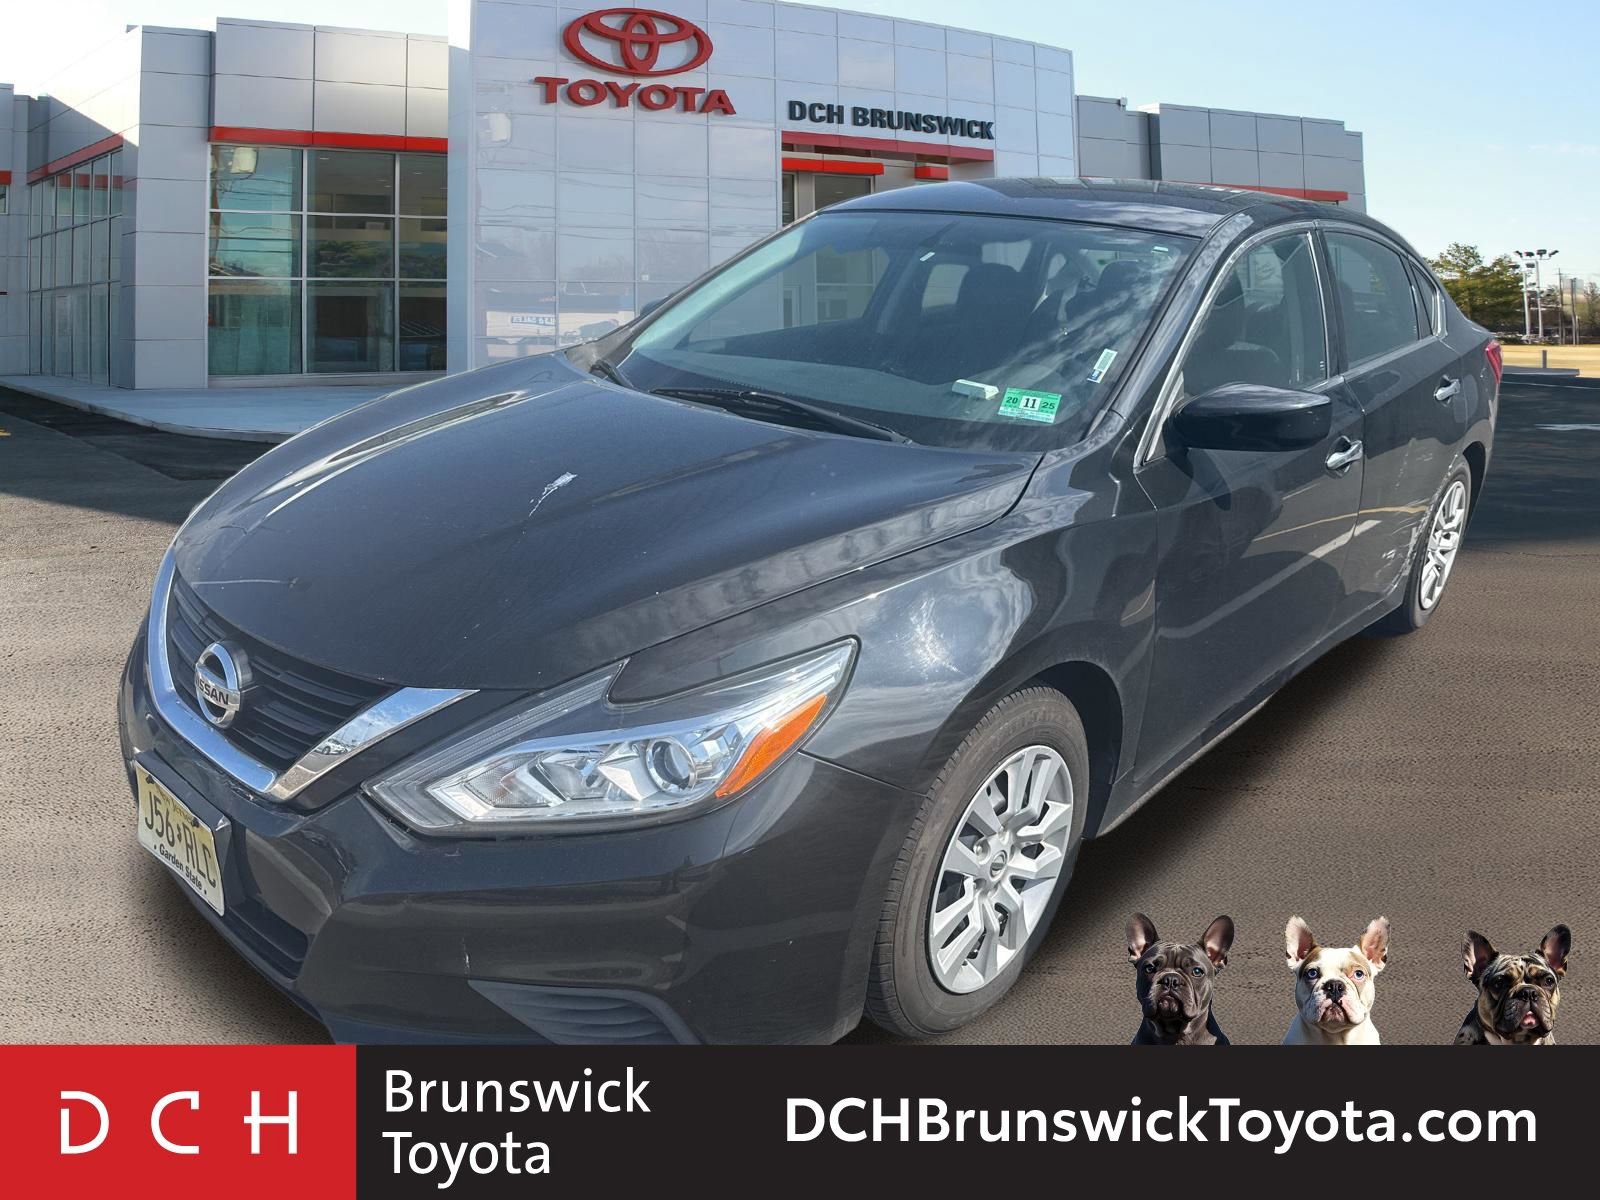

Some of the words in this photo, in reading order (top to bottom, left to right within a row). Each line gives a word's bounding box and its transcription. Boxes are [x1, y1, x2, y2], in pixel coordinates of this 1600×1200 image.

[534, 76, 737, 115] TOYOTA
[788, 100, 844, 124] DCH
[852, 106, 995, 140] BRUNSWICK
[1006, 396, 1018, 404] 20
[1023, 397, 1037, 409] 11
[1041, 401, 1055, 410] 25
[159, 843, 184, 872] Garden
[185, 867, 203, 891] State
